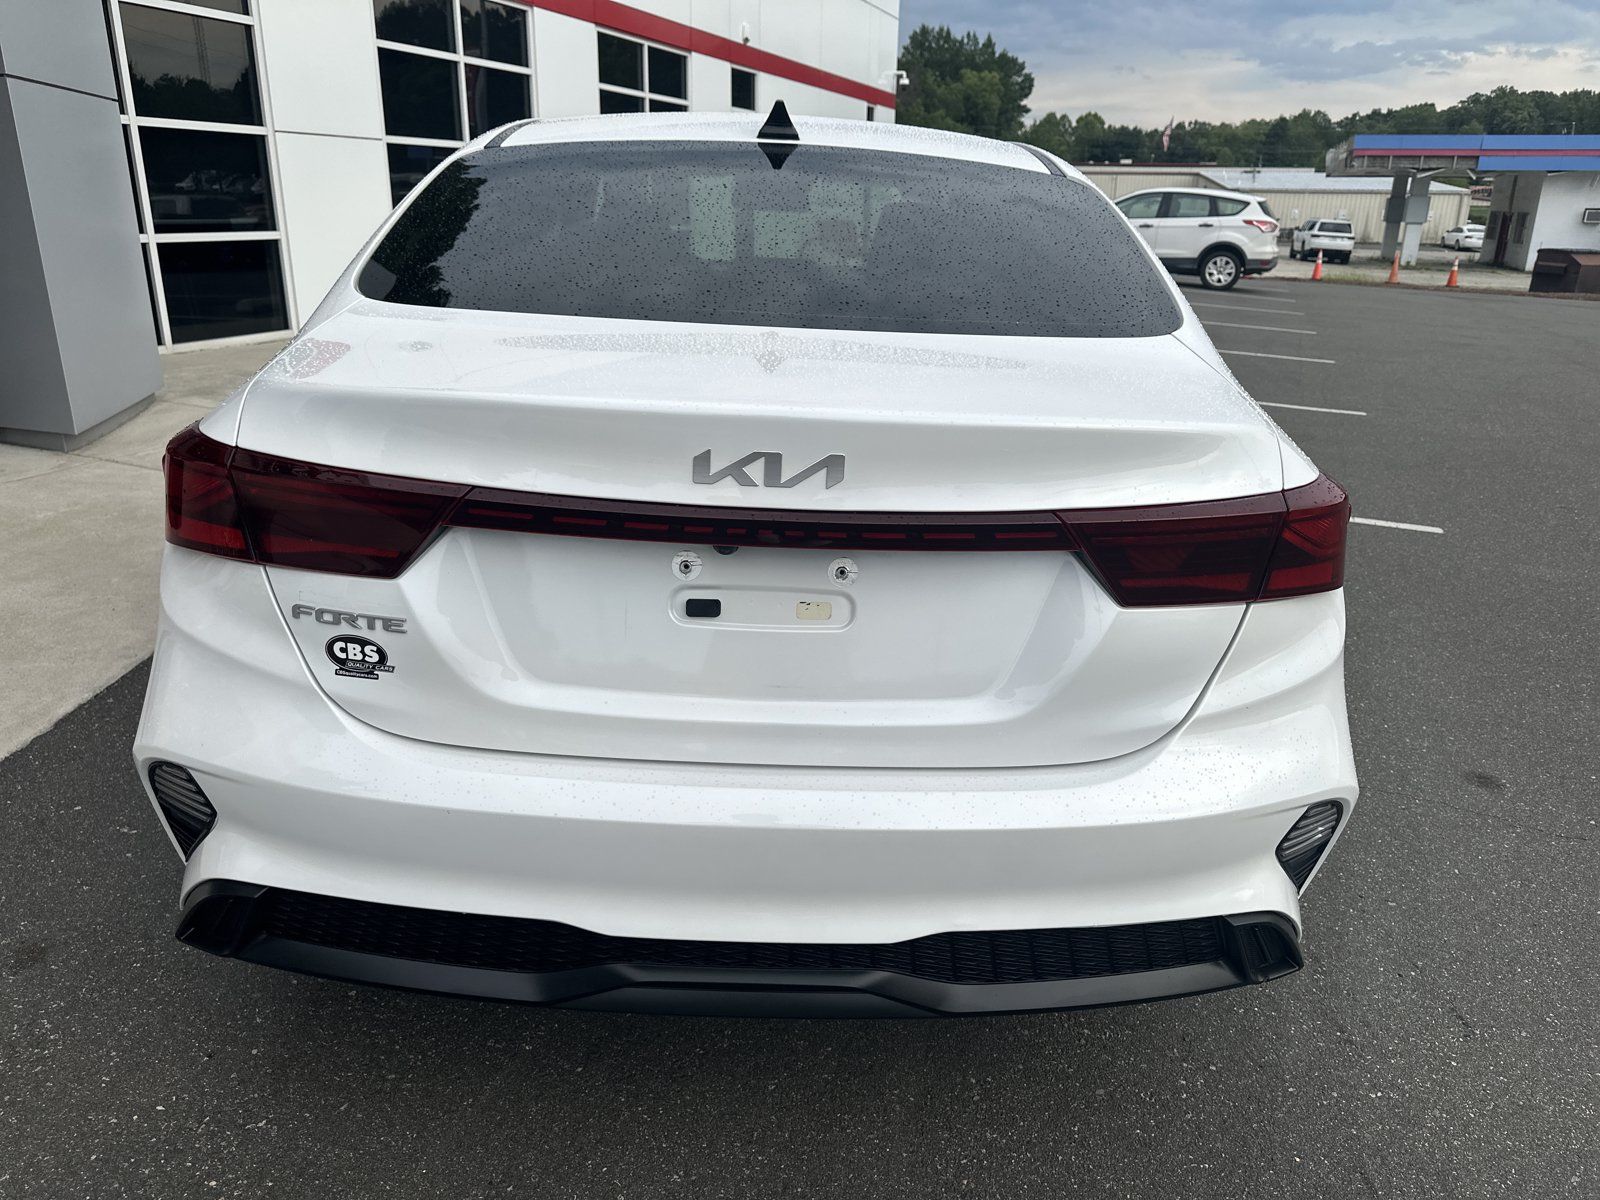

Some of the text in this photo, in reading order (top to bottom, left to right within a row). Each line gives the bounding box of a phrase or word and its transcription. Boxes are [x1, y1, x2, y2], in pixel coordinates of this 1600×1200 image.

[291, 603, 408, 634] FORTE
[333, 641, 380, 663] CBS
[347, 661, 373, 669] QUALITY
